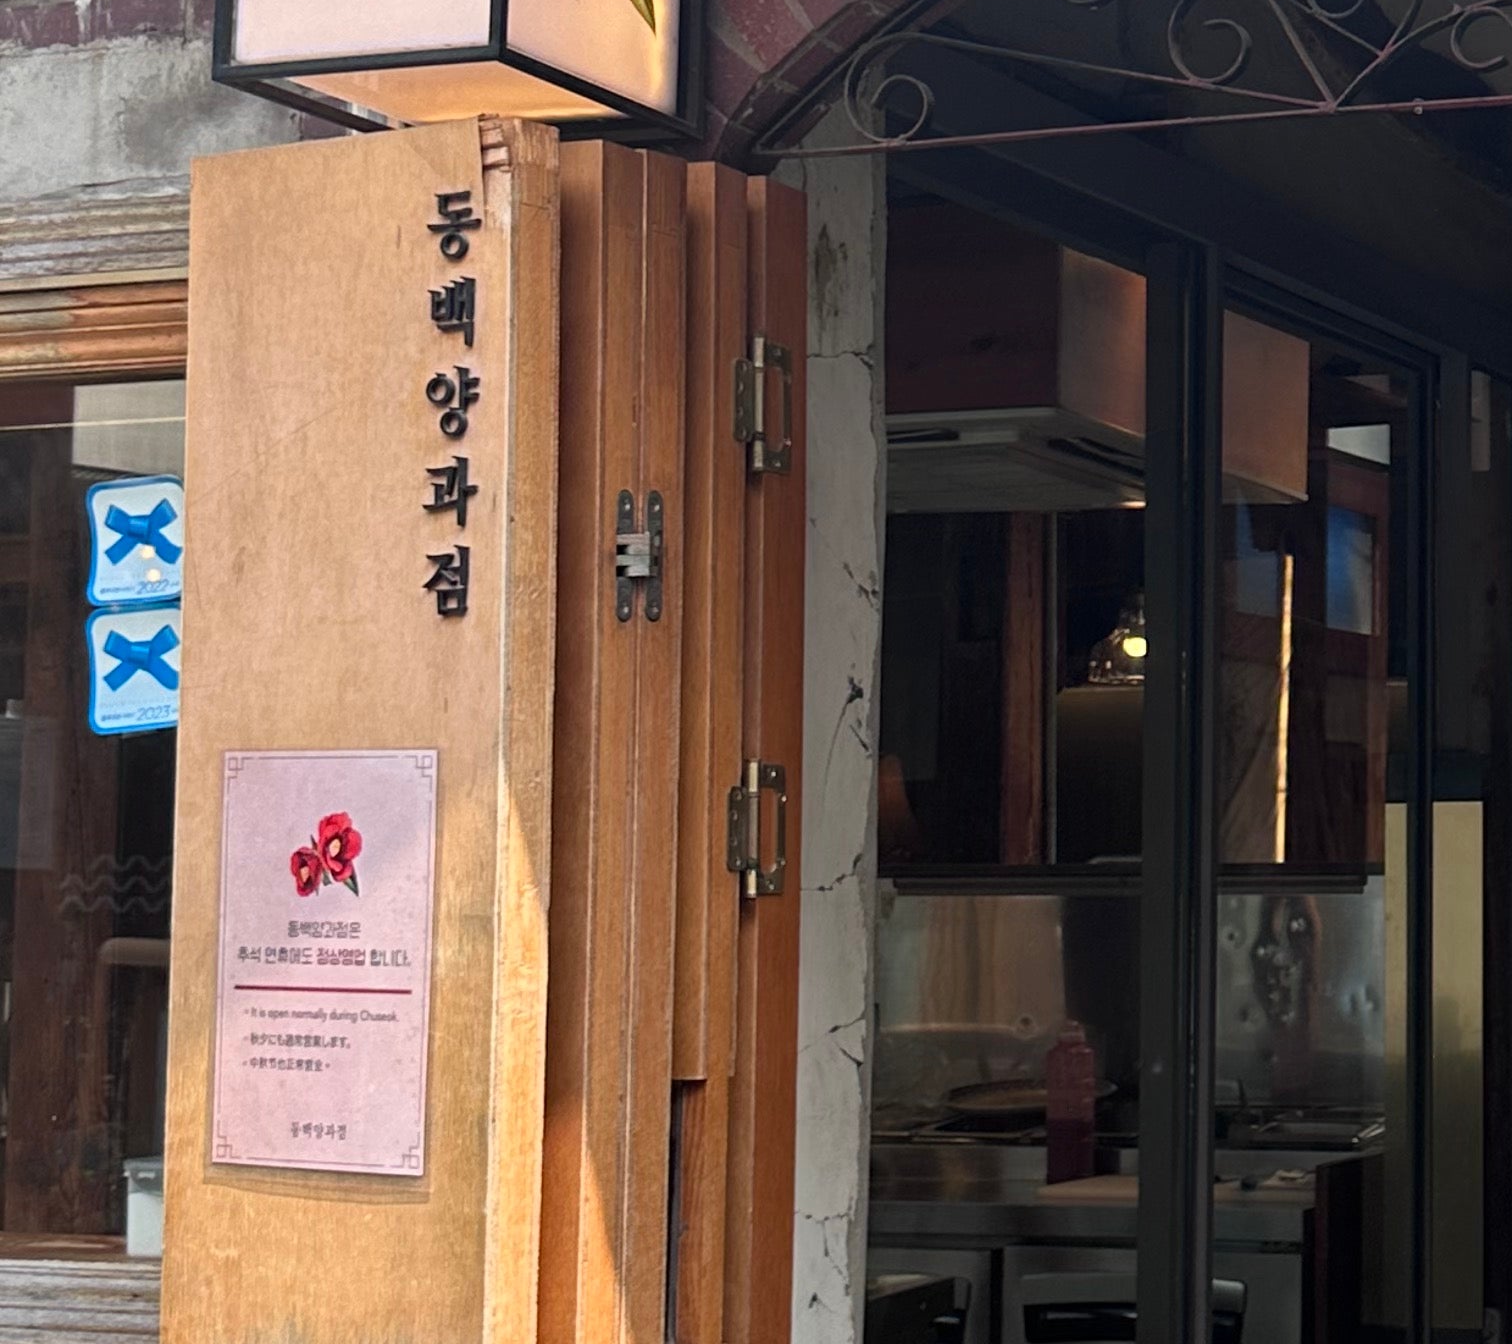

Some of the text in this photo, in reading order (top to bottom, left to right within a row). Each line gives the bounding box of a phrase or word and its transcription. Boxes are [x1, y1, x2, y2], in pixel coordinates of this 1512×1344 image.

[422, 190, 482, 618] 동백양과점
[136, 705, 170, 721] 2023
[288, 920, 361, 939] 동백양과점은
[238, 946, 262, 964] 추석
[265, 946, 313, 965] 연휴에도
[316, 947, 366, 966] 정상영업
[267, 1009, 289, 1021] open
[291, 1008, 328, 1022] normally
[329, 1009, 358, 1023] during
[290, 1121, 347, 1141] 동백양과점
